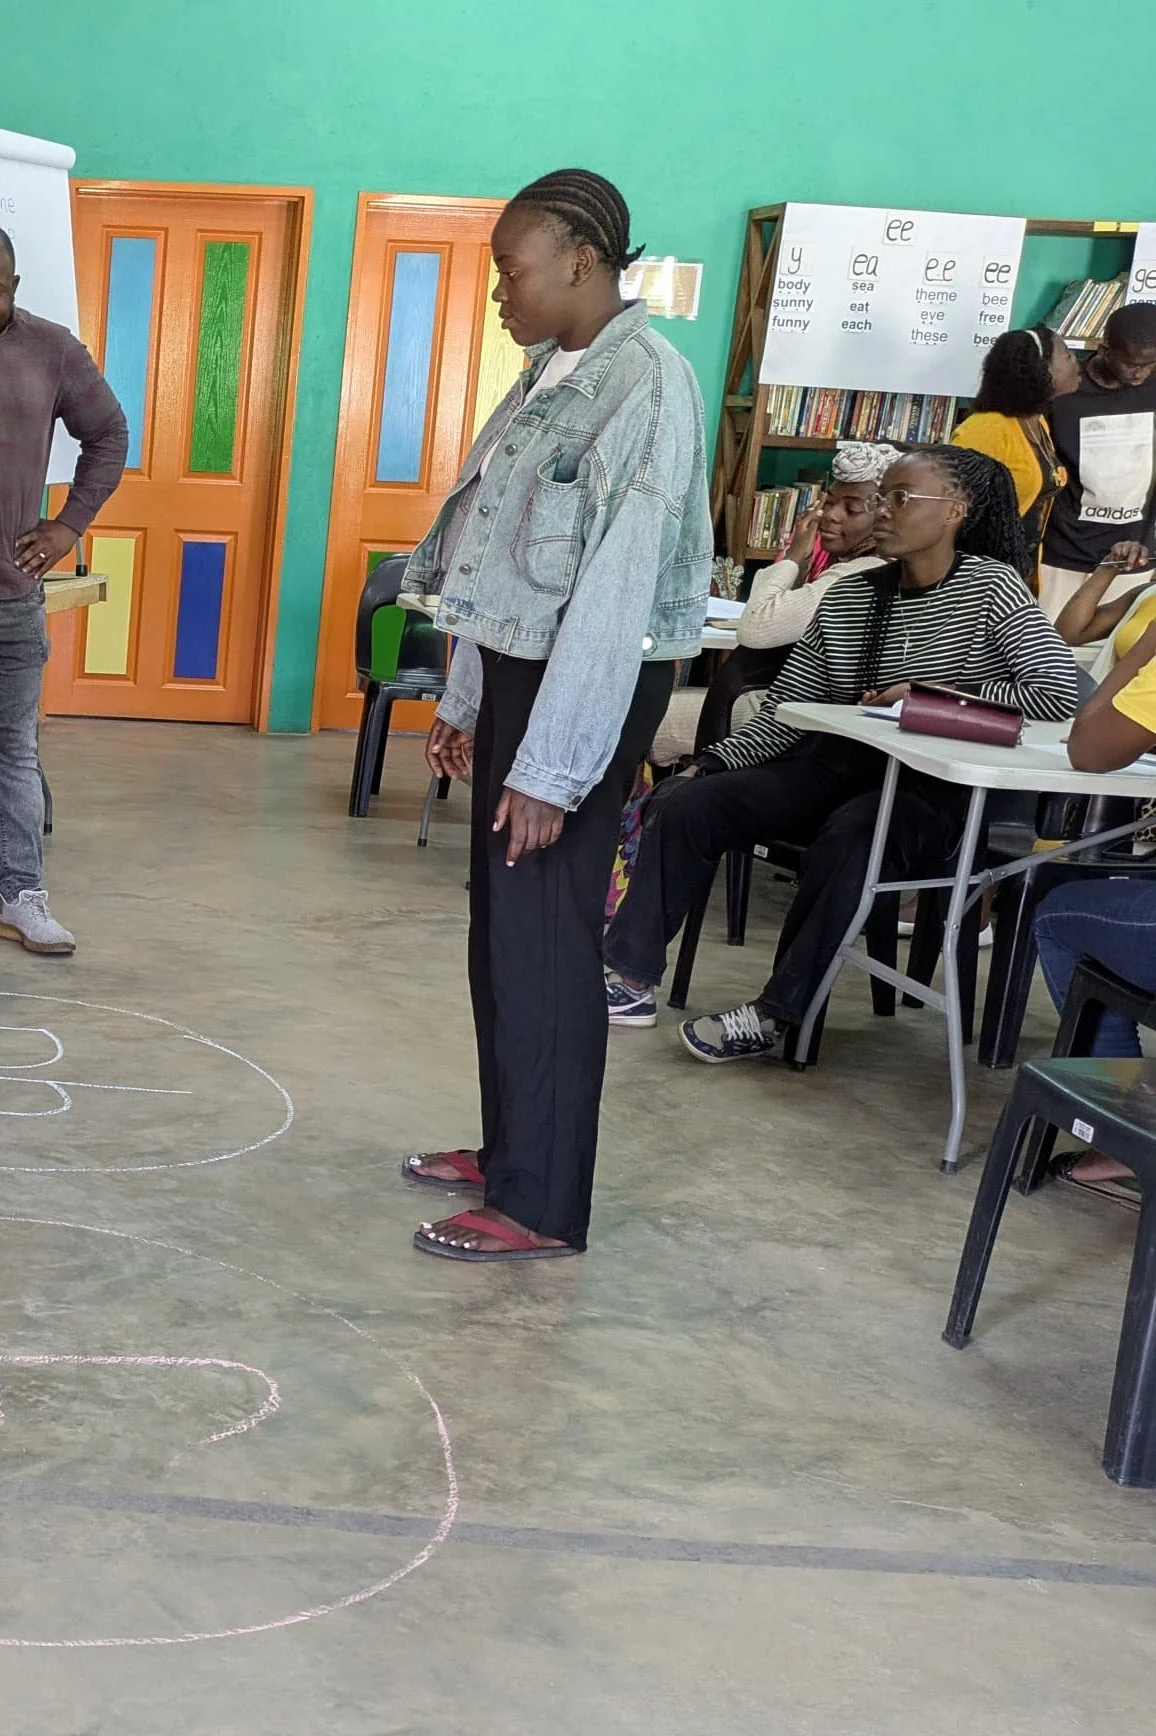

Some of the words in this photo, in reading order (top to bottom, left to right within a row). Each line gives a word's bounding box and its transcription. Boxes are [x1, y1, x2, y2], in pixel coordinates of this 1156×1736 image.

[886, 218, 914, 241] ee
[787, 247, 802, 275] y
[852, 253, 879, 277] ea
[984, 262, 1012, 284] ee
[778, 278, 811, 295] body
[852, 281, 874, 291] sea
[916, 288, 957, 302] theme
[982, 292, 1008, 306] bee
[773, 298, 813, 311] sunny
[850, 300, 870, 312] eat
[920, 309, 945, 321] eve
[979, 310, 1005, 323] free
[772, 315, 810, 331] funny
[841, 319, 872, 331] each
[911, 329, 948, 343] these
[973, 333, 998, 346] bee
[1084, 505, 1141, 520] adidas
